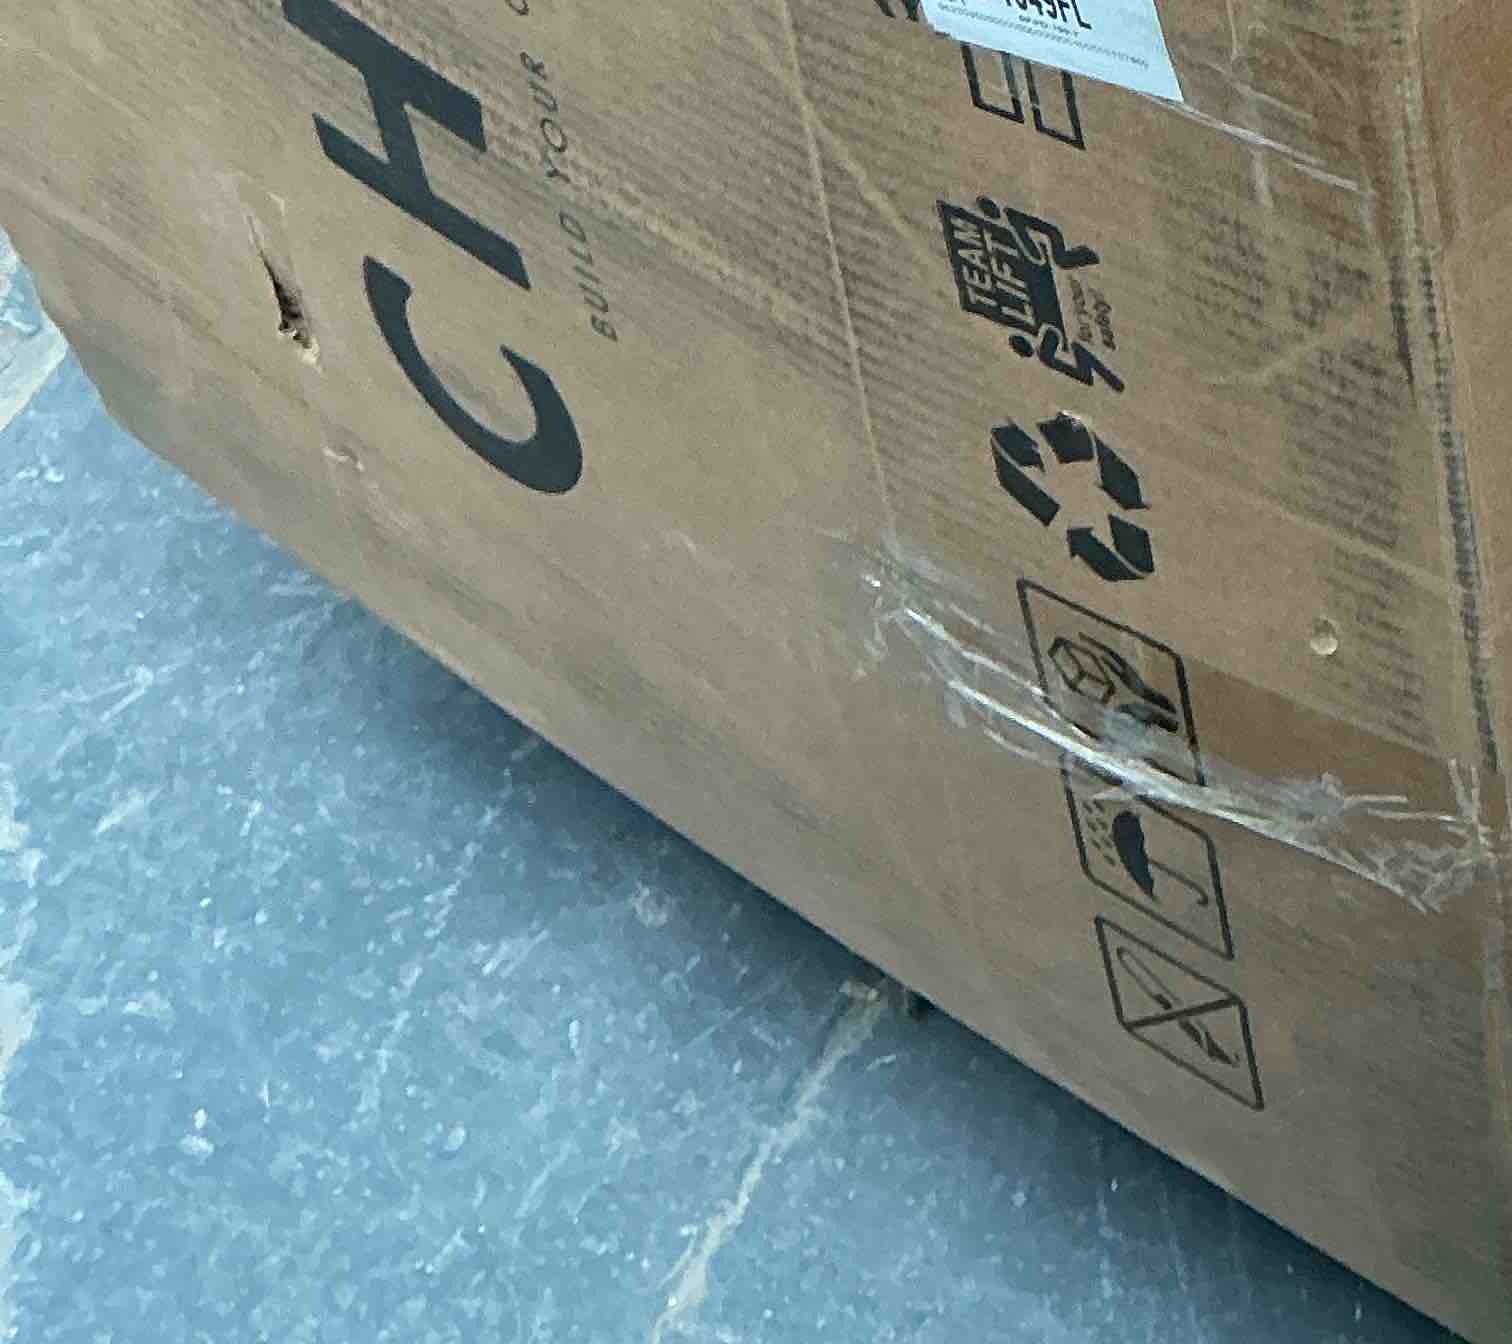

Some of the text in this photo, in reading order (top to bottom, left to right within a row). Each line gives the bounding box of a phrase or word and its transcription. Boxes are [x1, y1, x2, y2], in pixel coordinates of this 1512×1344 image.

[519, 50, 573, 183] YOUR
[558, 210, 619, 342] BUILD
[950, 217, 998, 306] TEAM
[982, 227, 1038, 330] LIFT
